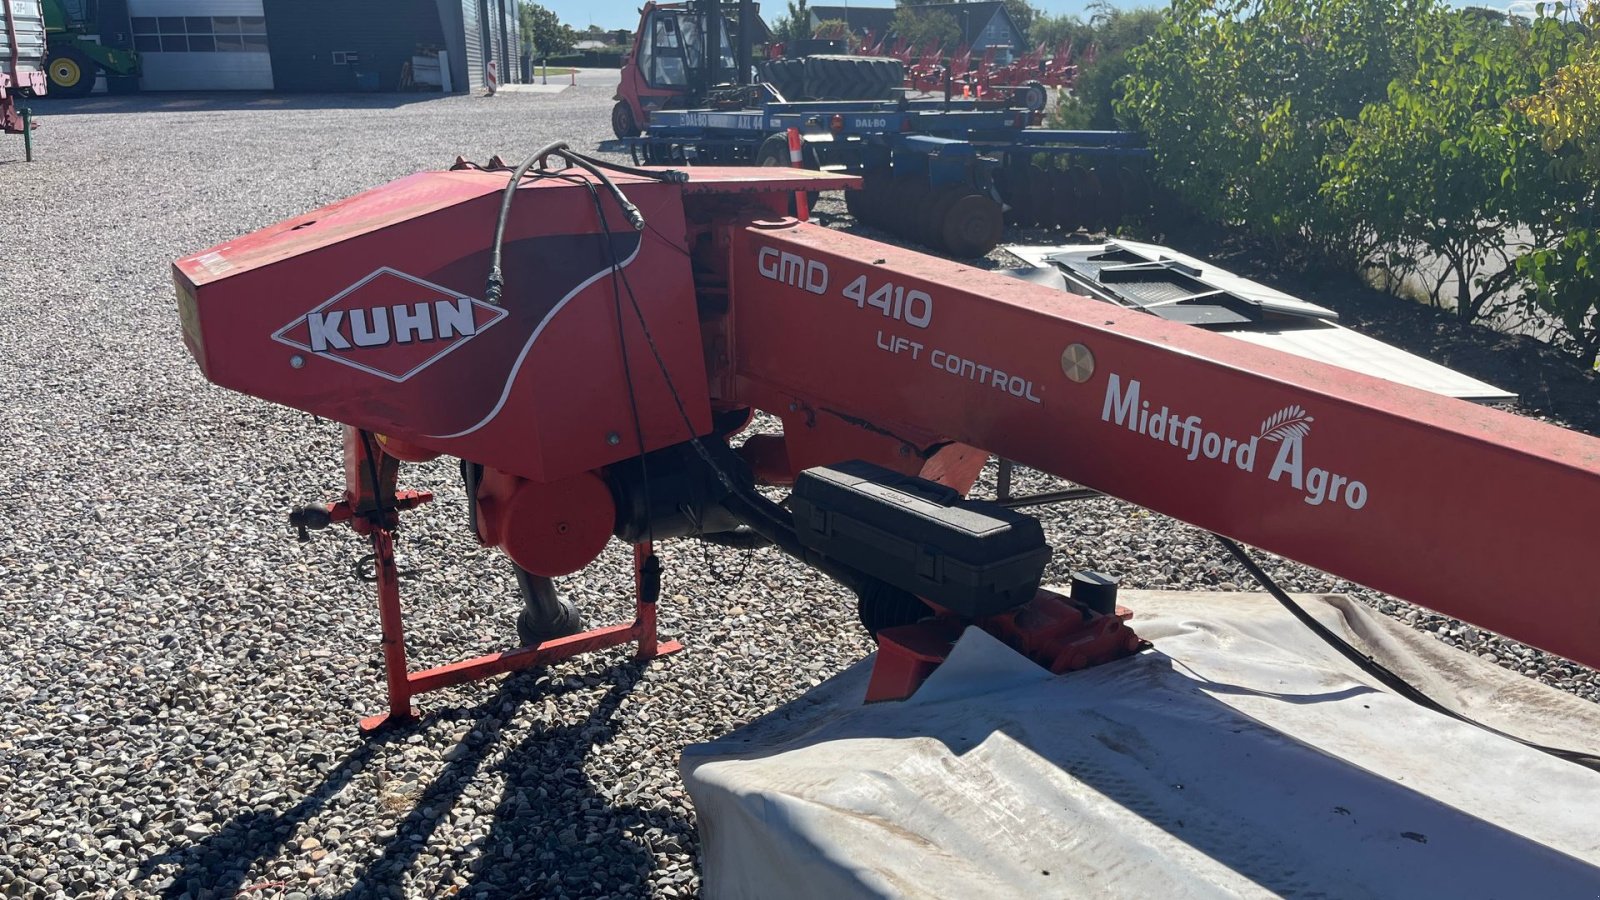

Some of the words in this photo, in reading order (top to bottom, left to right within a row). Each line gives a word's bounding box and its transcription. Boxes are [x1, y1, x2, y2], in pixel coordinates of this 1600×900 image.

[307, 298, 476, 352] KUHN
[758, 246, 829, 295] GMD
[842, 274, 933, 329] 4410
[876, 330, 924, 360] LIFT
[931, 349, 1041, 404] CONTROL
[1101, 372, 1258, 473] Midtfjord
[1268, 432, 1368, 510] Agro
